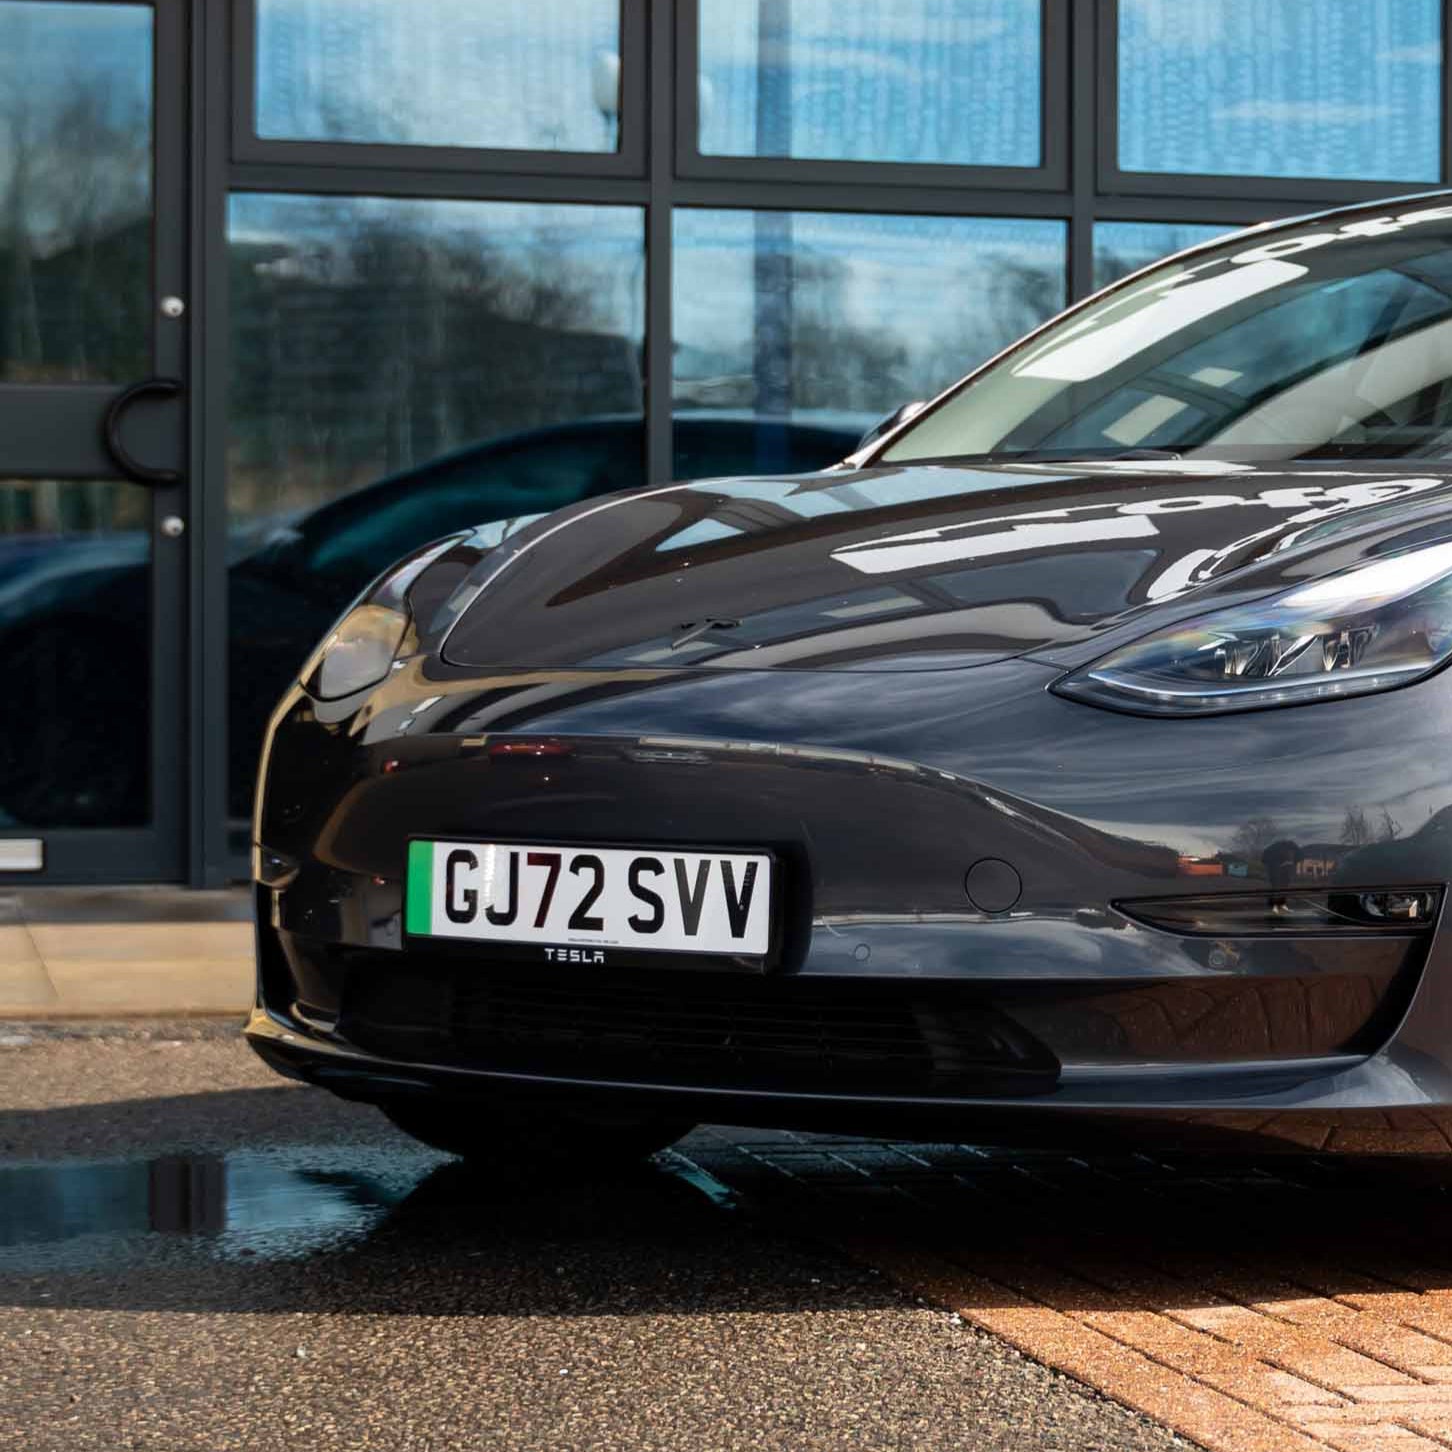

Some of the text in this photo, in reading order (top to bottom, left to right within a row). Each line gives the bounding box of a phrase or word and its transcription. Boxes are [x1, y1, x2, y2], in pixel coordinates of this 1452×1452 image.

[445, 849, 759, 939] GJ72 SVV
[544, 948, 605, 964] TESLA
